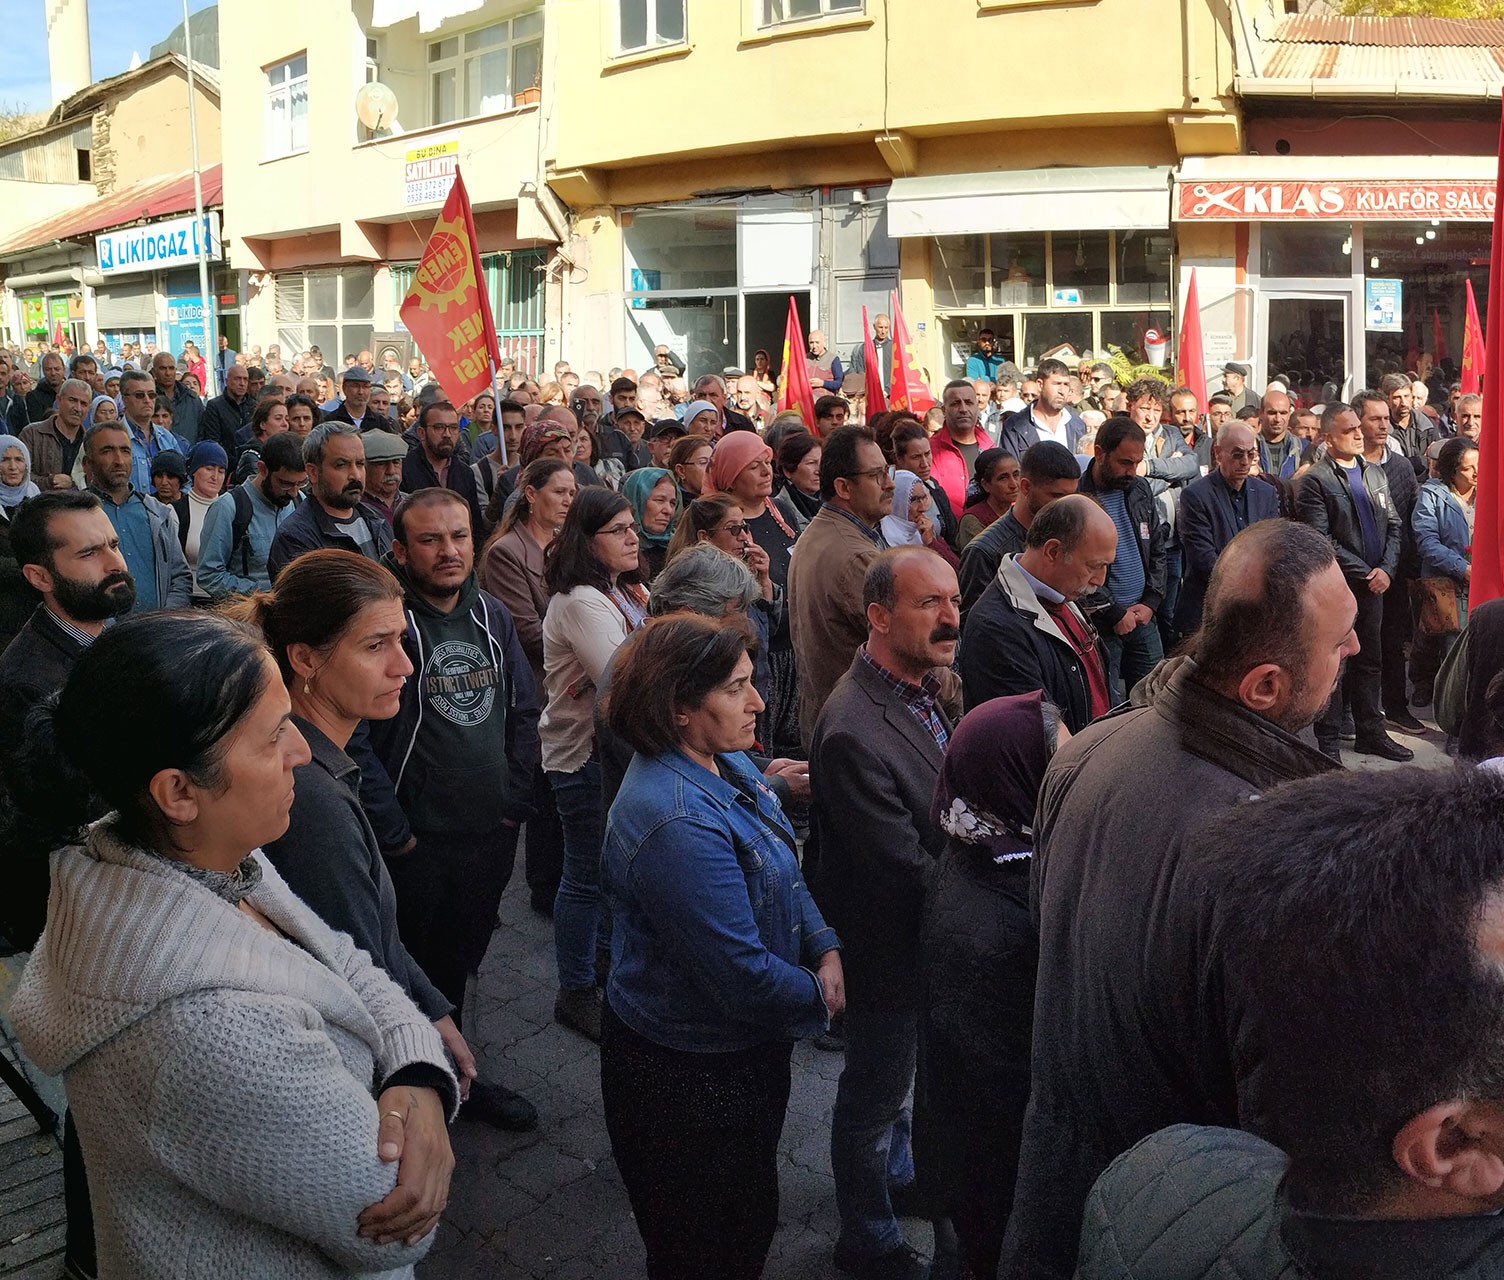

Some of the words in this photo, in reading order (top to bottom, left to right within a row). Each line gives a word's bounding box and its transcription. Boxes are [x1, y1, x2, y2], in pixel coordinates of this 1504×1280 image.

[1244, 186, 1345, 214] KLAS
[1356, 189, 1440, 211] KUAFÖR
[118, 230, 188, 265] LİKİDGAZ
